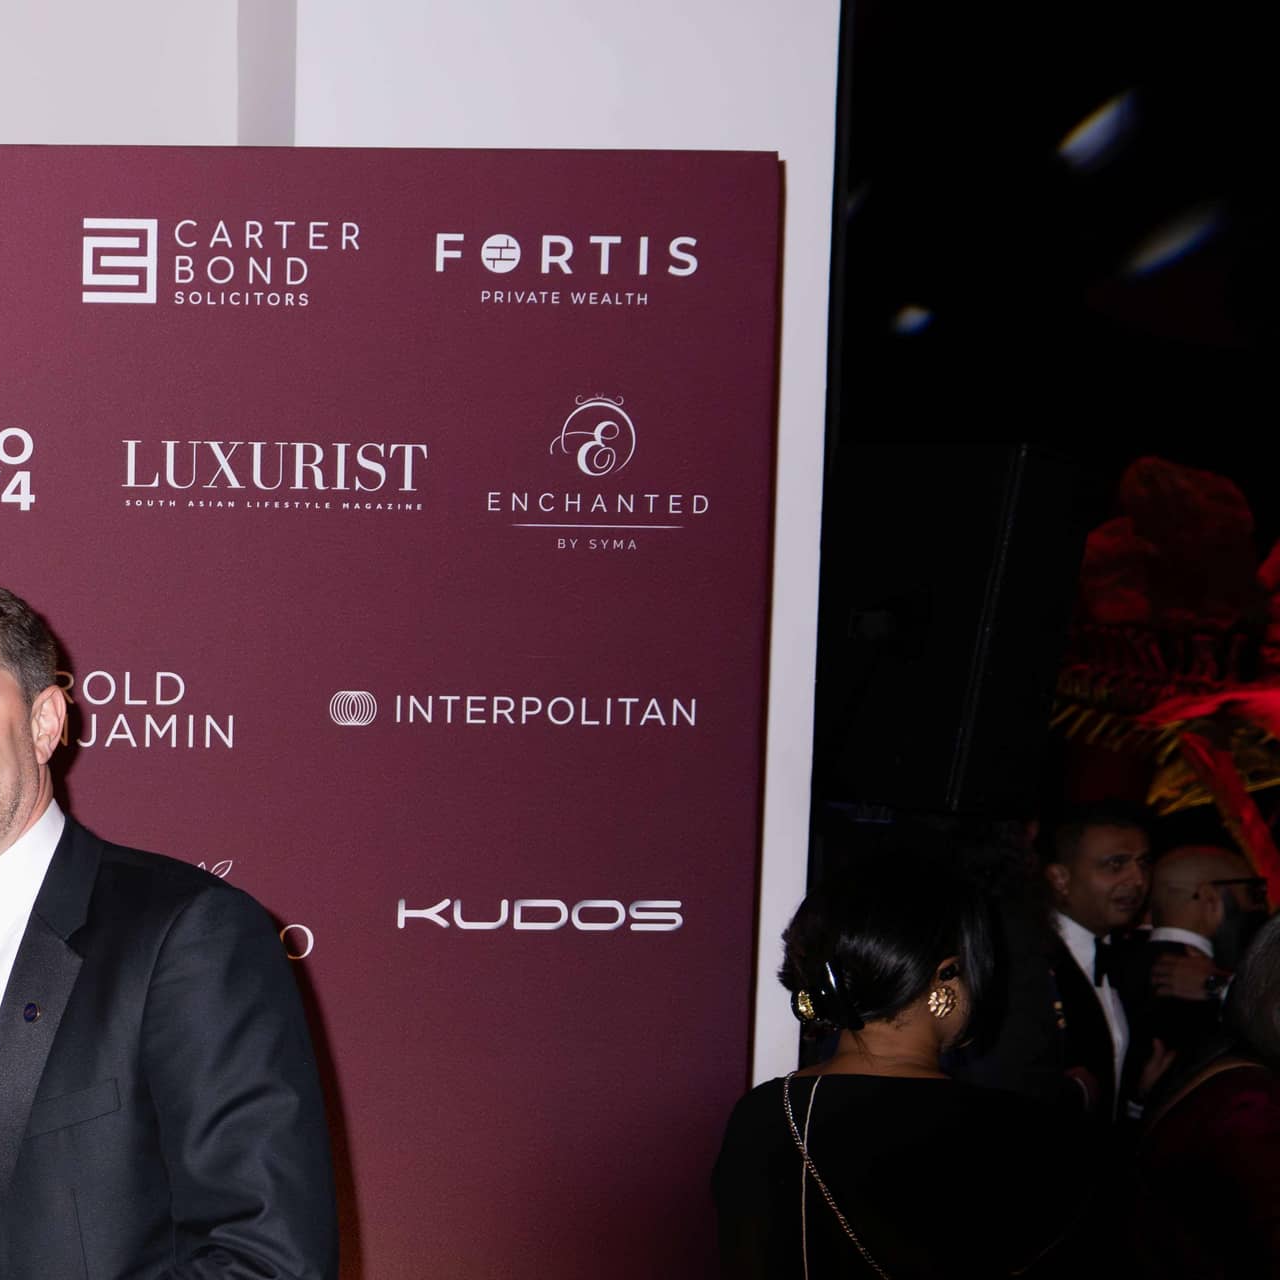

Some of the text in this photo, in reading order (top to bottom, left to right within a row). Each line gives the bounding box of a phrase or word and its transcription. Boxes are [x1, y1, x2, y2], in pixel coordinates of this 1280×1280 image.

[174, 219, 360, 251] CARTER
[174, 255, 308, 286] BOND
[435, 232, 698, 277] FORTIS
[174, 290, 309, 307] SOLICITORS
[480, 290, 648, 305] PRIVATE WEALTH
[121, 439, 428, 492] LUXURIST
[125, 499, 422, 511] SOUTH ASIAN LIFESTYLE MAGAZINE
[487, 491, 709, 514] ENCHANTED
[557, 538, 637, 550] BY SYMA
[55, 670, 185, 706] ROLD
[395, 694, 696, 726] INTERPOLITAN
[61, 713, 234, 749] JAMIN
[396, 898, 684, 932] KUDOS
